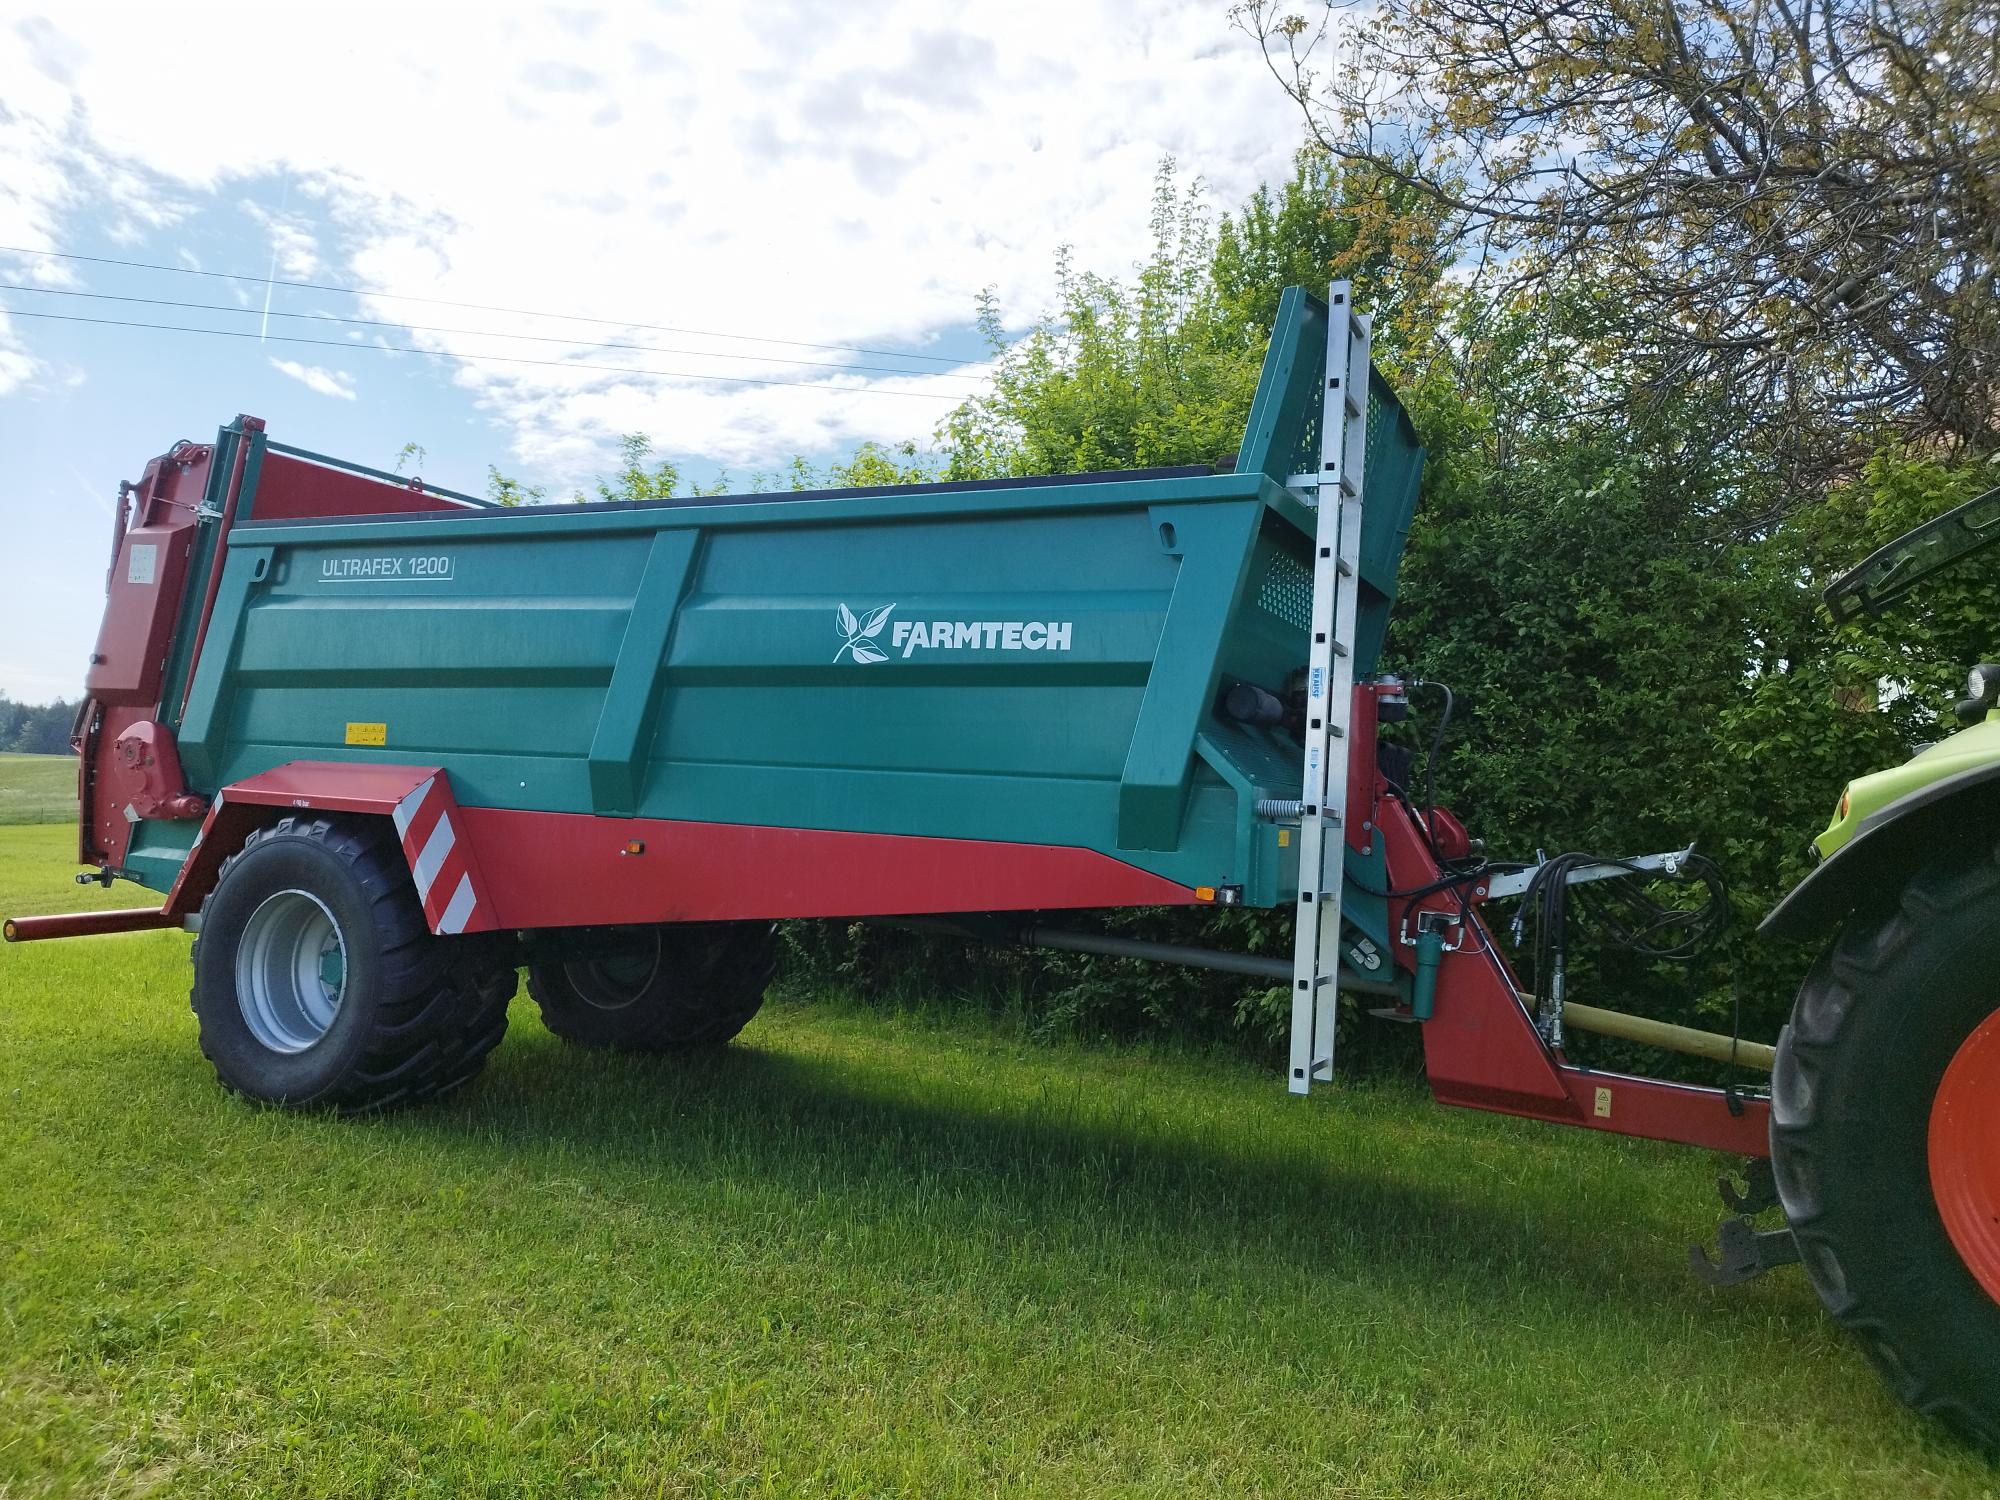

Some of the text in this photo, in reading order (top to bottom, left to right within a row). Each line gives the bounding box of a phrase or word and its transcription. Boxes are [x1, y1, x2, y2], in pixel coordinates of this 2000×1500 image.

[322, 556, 449, 576] ULTRAFEX 1200
[891, 621, 1073, 659] FARMTECH
